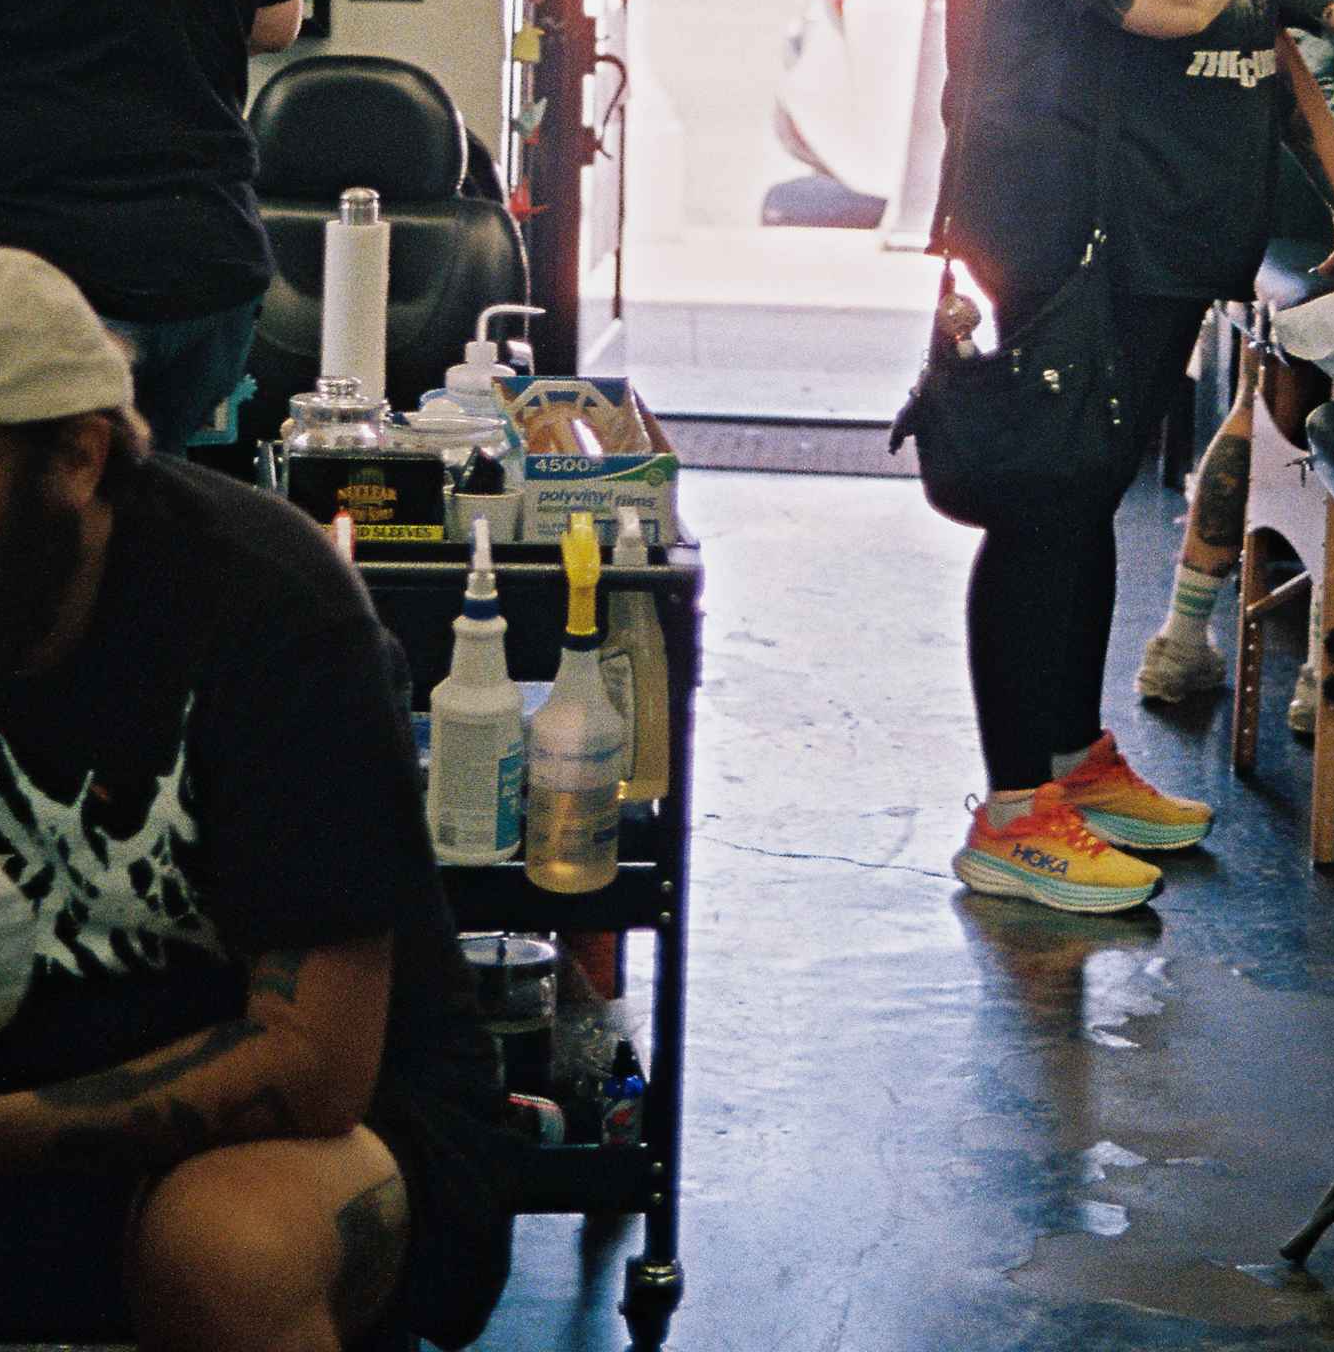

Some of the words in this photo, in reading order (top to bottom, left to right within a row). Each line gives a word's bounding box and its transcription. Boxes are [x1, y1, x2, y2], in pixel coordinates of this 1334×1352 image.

[534, 458, 590, 472] 4500
[373, 526, 432, 538] SLEEVES
[1010, 843, 1068, 875] HOKA
